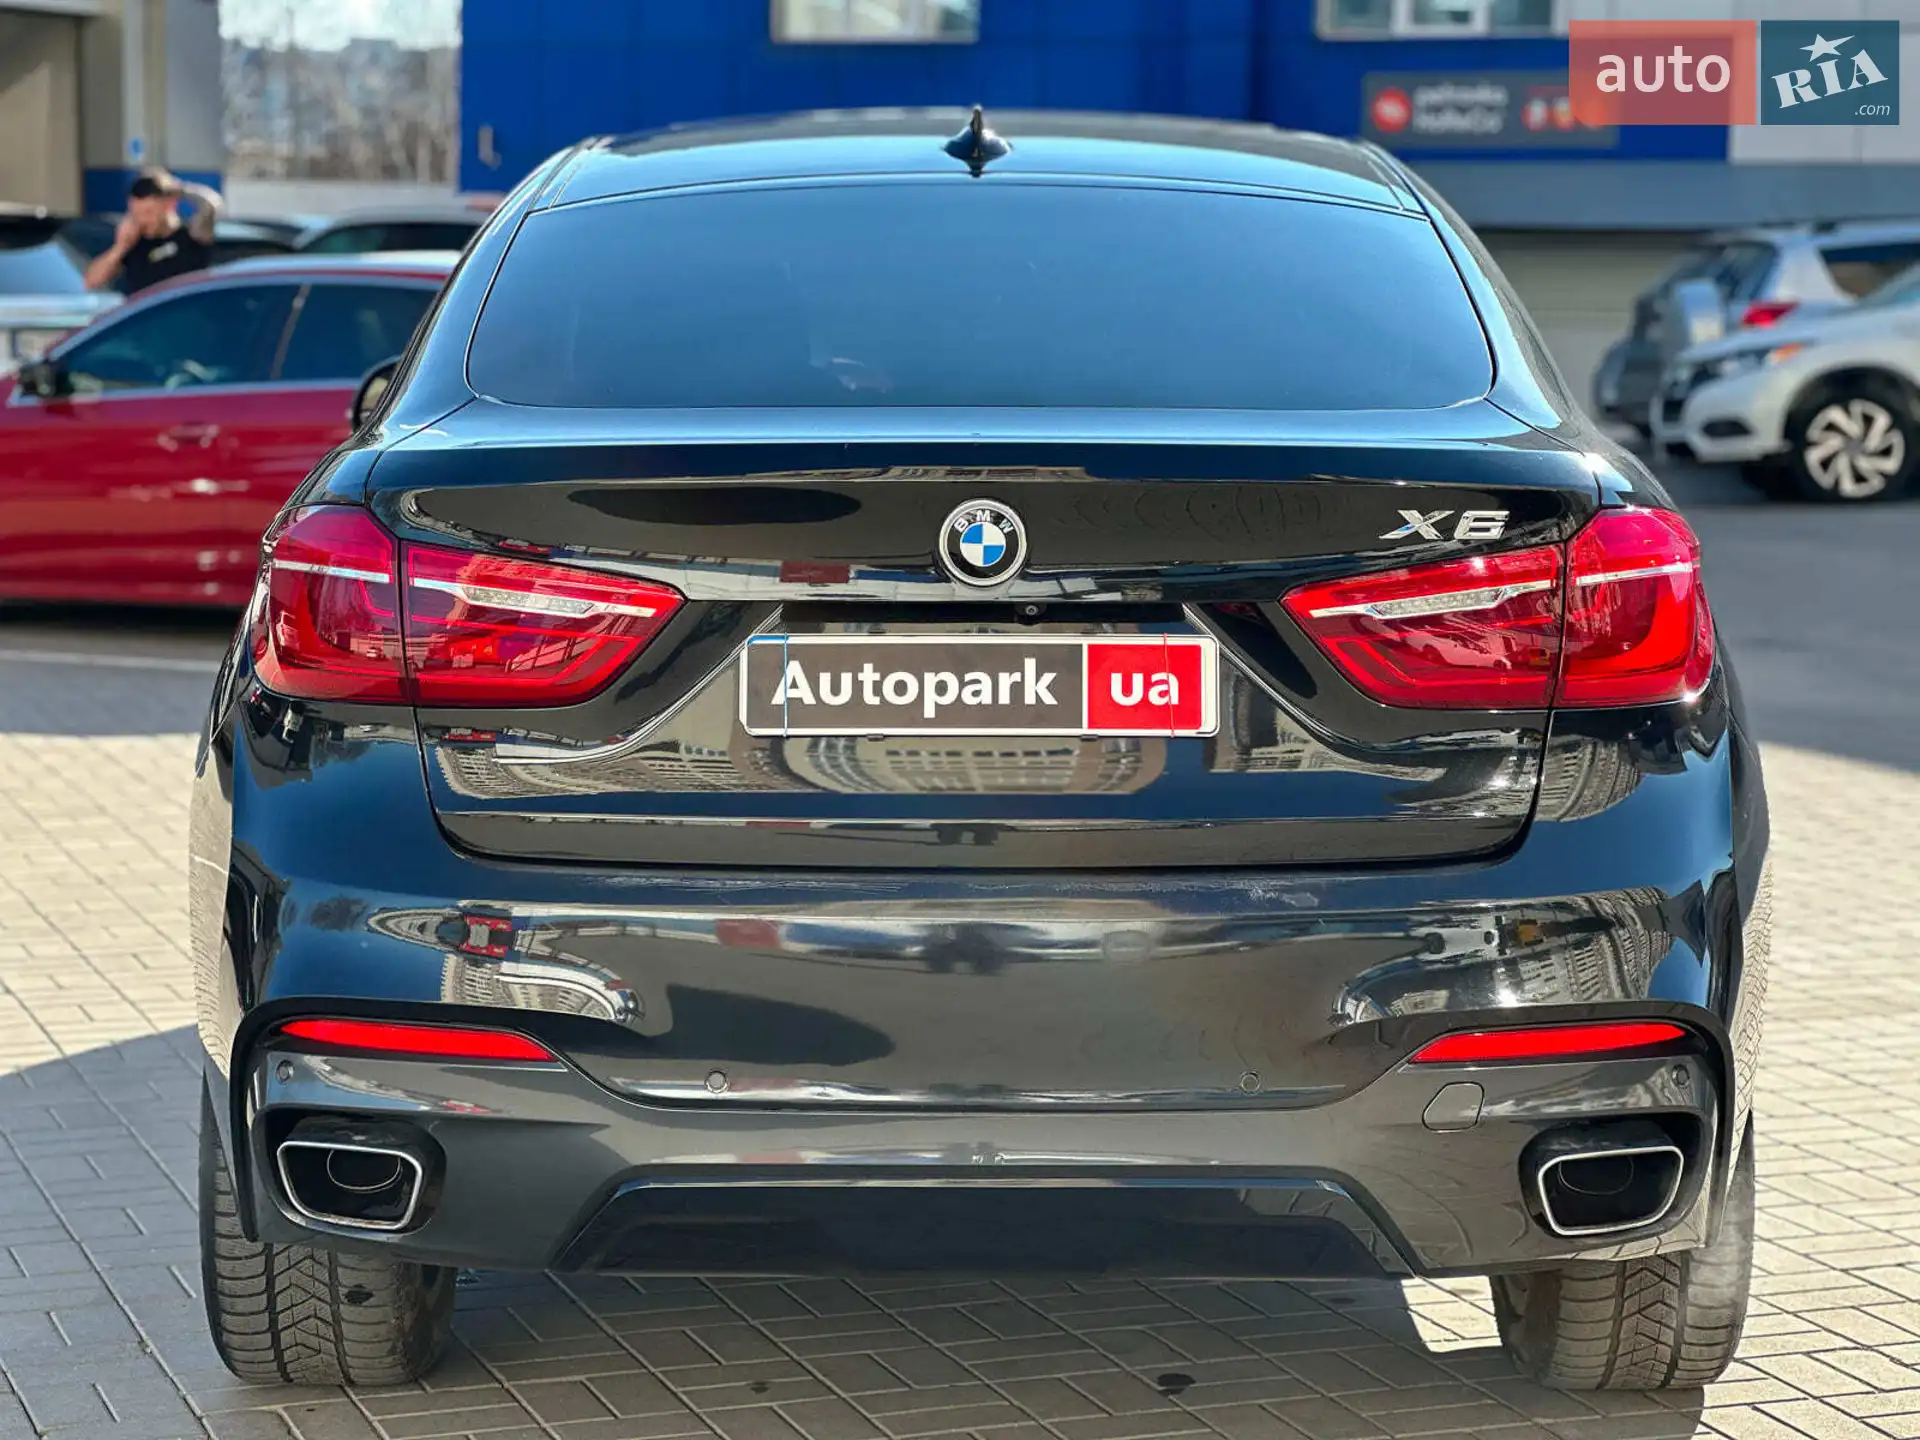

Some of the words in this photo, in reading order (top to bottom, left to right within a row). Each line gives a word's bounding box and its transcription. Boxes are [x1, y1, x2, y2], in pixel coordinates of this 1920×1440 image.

[953, 509, 1014, 534] BMW
[1378, 509, 1511, 540] X6
[770, 657, 1059, 718] Autopark
[1109, 670, 1180, 706] ua
